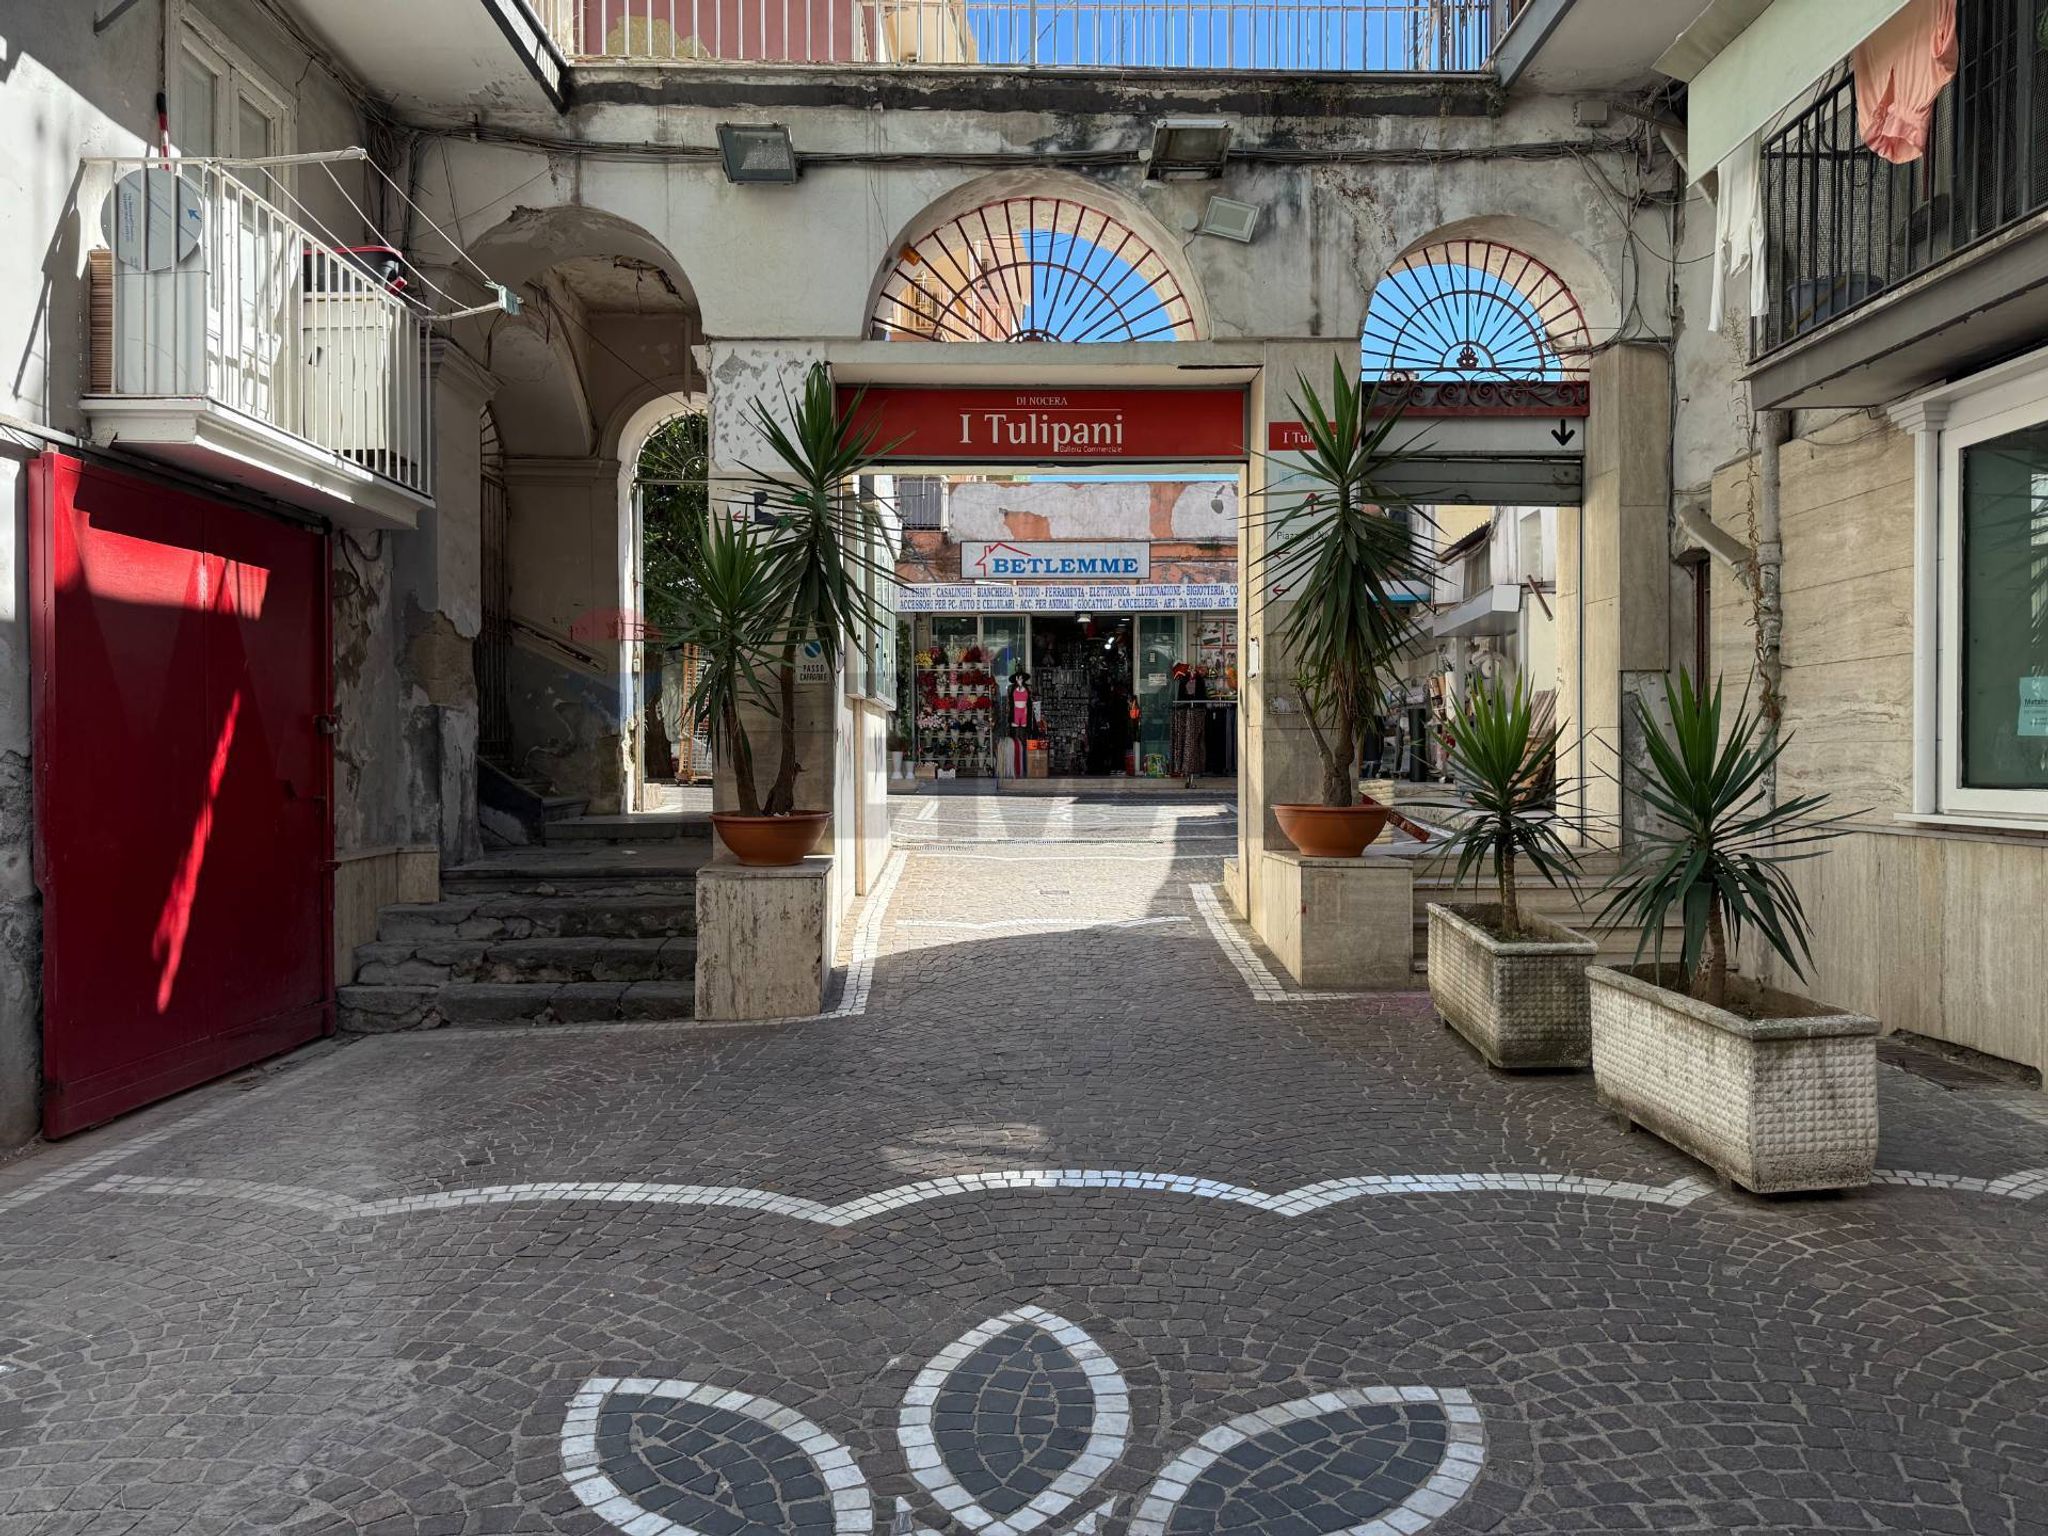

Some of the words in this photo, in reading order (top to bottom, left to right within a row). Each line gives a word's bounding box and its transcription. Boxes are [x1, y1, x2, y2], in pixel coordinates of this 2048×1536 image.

[1016, 397, 1026, 406] DI
[1029, 397, 1068, 406] NOCERA
[959, 414, 973, 444] I
[984, 414, 1123, 452] Tulipani
[1083, 445, 1122, 453] Commerciale
[993, 558, 1138, 573] BETLEMME
[936, 587, 972, 598] CASALINGHI
[977, 587, 1014, 598] BIANCHERIA
[1018, 587, 1040, 598] INTIMO
[1045, 586, 1085, 597] FERRAMENTA
[1089, 586, 1130, 597] ELETTRONICA
[1135, 585, 1181, 597] ILLUMINAZIONE
[1186, 585, 1225, 596] BIGIOTTERIA
[899, 599, 933, 610] ACCESSORI
[935, 599, 947, 610] PER
[959, 599, 975, 610] AUTO
[982, 599, 1015, 610] CELLULARI
[1035, 599, 1047, 609] PER
[1049, 599, 1073, 609] ANIMALI
[1077, 598, 1113, 609] GIOCATTOLI
[1118, 598, 1158, 609] CANCELLERIA
[1179, 598, 1188, 608] DA
[1189, 598, 1212, 609] REGALO
[803, 664, 825, 673] PASSO
